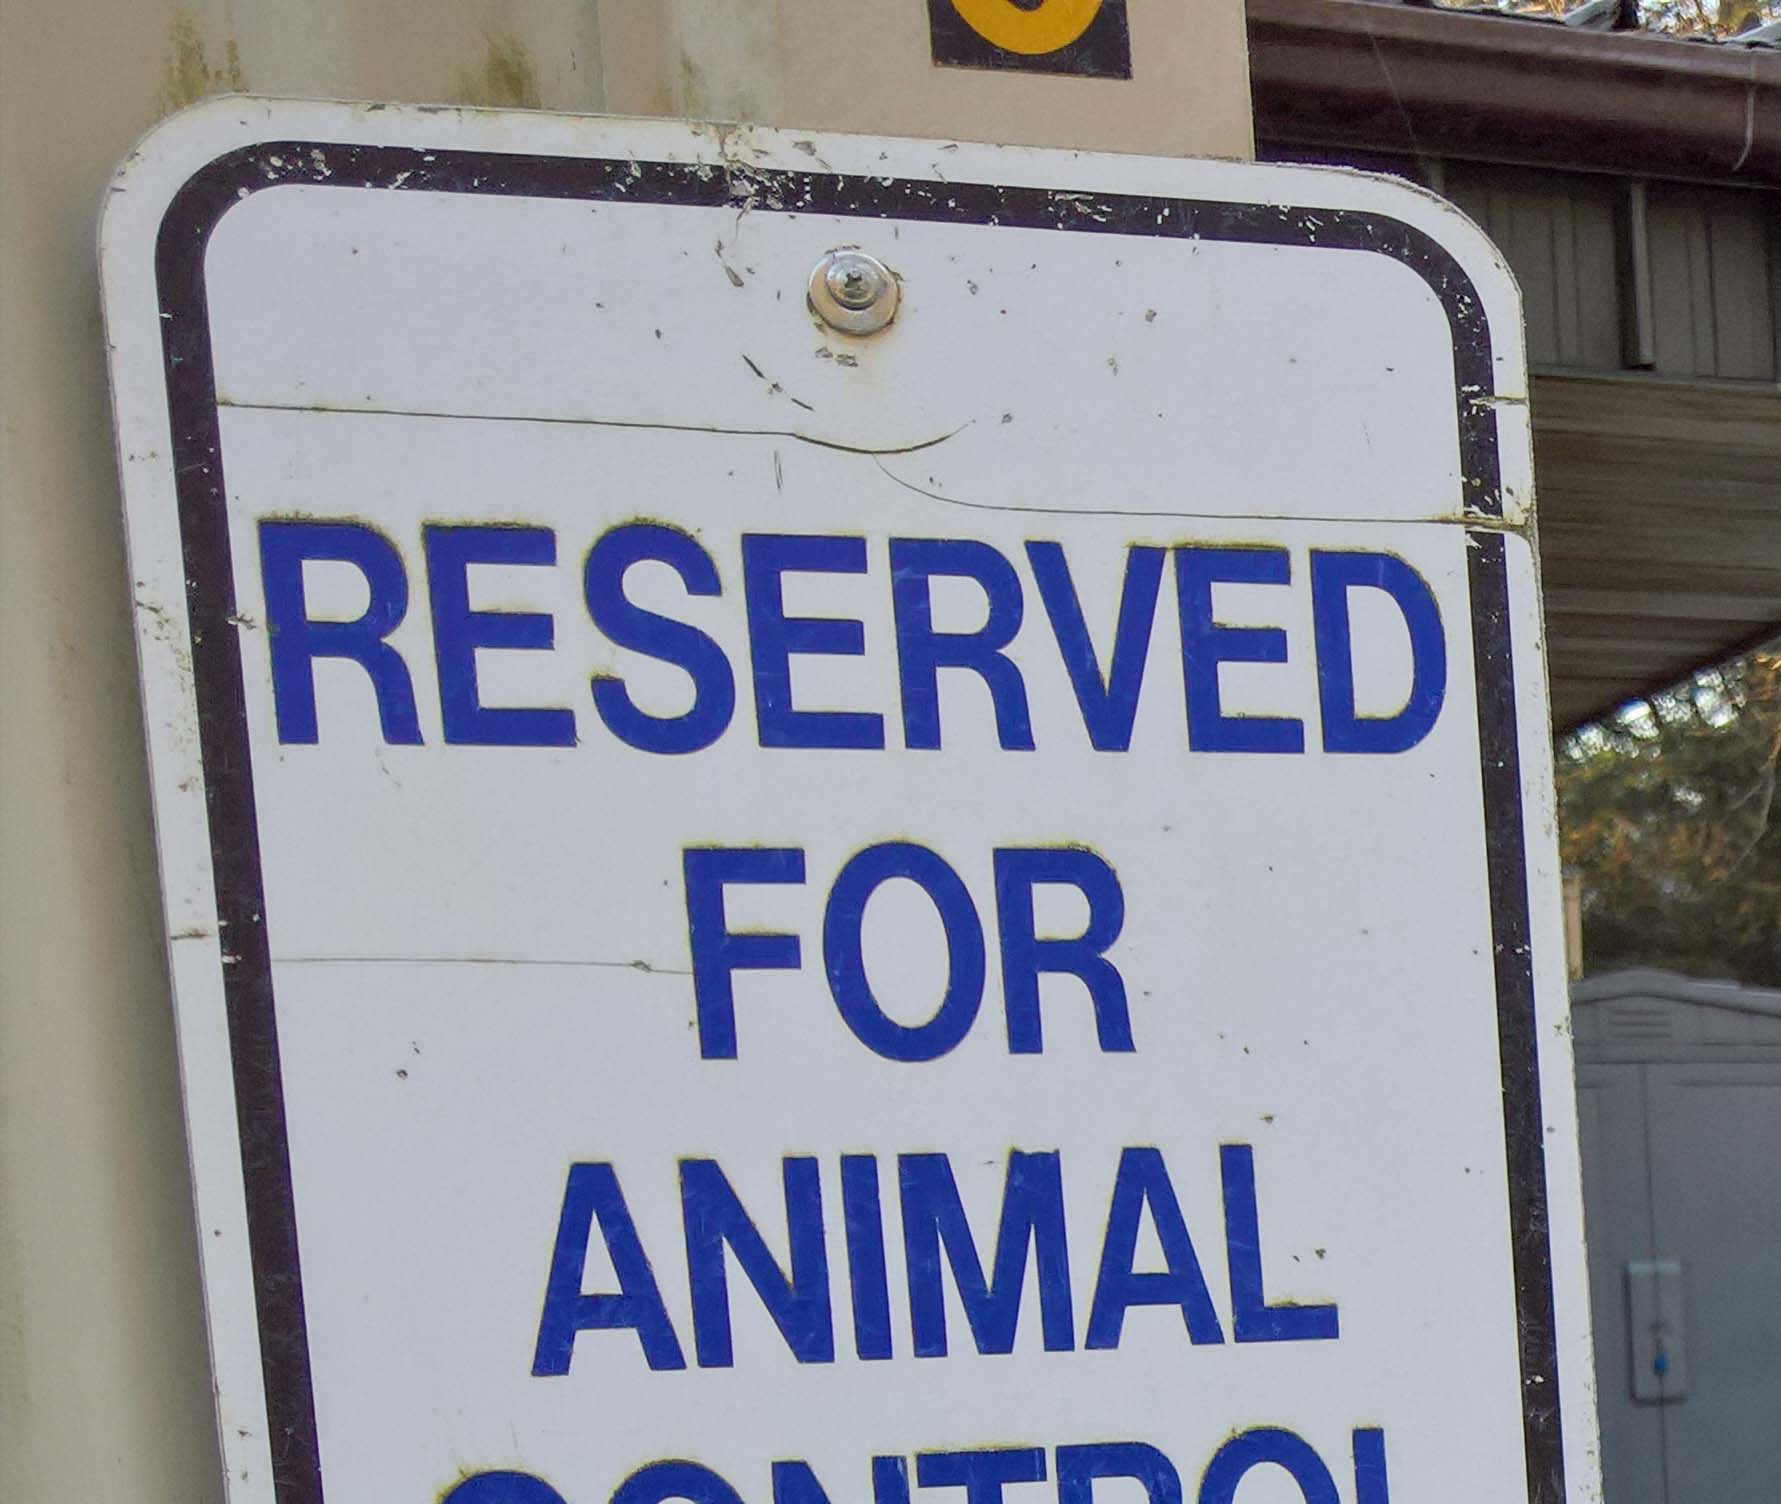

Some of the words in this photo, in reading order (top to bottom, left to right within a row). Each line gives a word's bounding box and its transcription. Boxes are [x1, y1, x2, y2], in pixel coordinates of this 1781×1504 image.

[256, 514, 1449, 756] RESERVED
[682, 838, 1139, 1064] FOR
[530, 1142, 1340, 1378] ANIMAL
